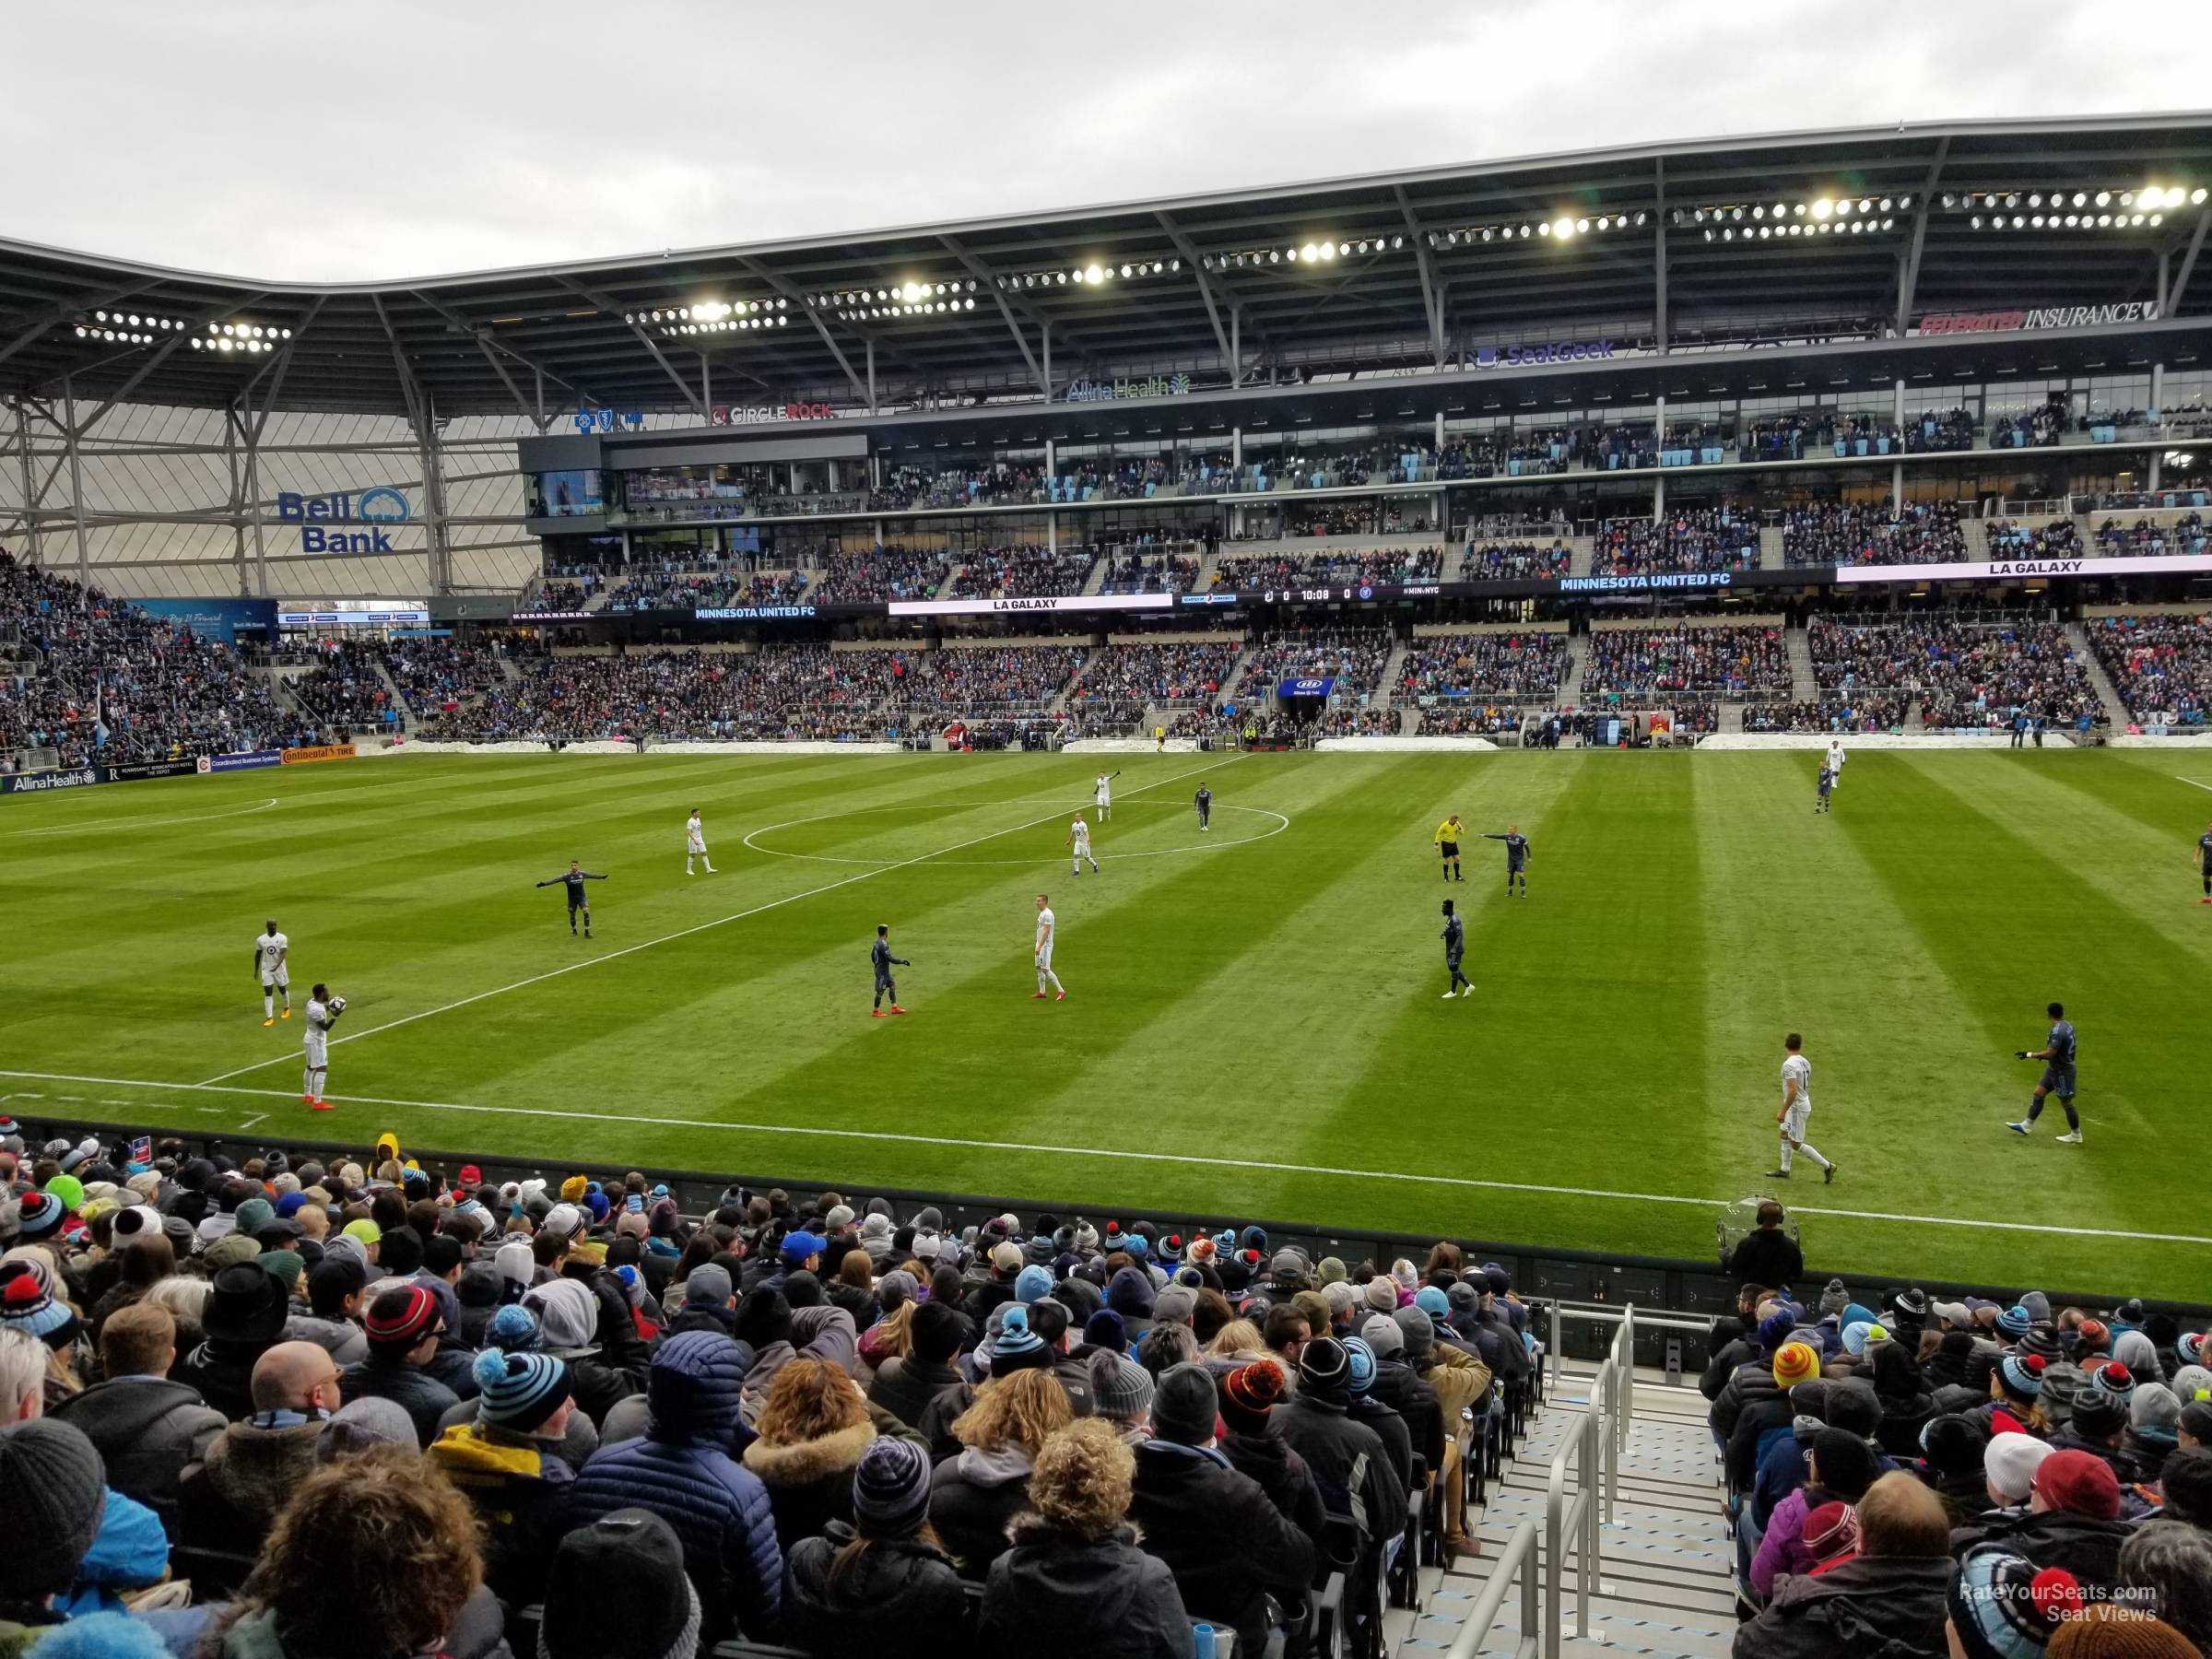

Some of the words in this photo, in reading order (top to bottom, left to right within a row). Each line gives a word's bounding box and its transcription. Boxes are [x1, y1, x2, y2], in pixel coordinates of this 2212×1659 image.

[2023, 302, 2144, 330] INSURANCE
[1507, 337, 1614, 366] SeatGeek
[278, 492, 350, 522] Bell
[301, 526, 394, 554] Bank
[1990, 564, 2011, 574] LA
[2016, 561, 2082, 573] GALAXY
[1560, 576, 1648, 591] MINNESOTA
[1651, 574, 1707, 587] UNITED
[1711, 573, 1730, 584] FC
[696, 608, 758, 618] MINNESOTA
[759, 606, 799, 617] UNITED
[801, 606, 816, 616] FC
[994, 601, 1009, 610] LA
[1011, 599, 1057, 609] GALAXY
[211, 759, 242, 767] Coordinated
[283, 748, 328, 764] Continental
[336, 747, 354, 756] TIRE
[110, 768, 121, 781] R
